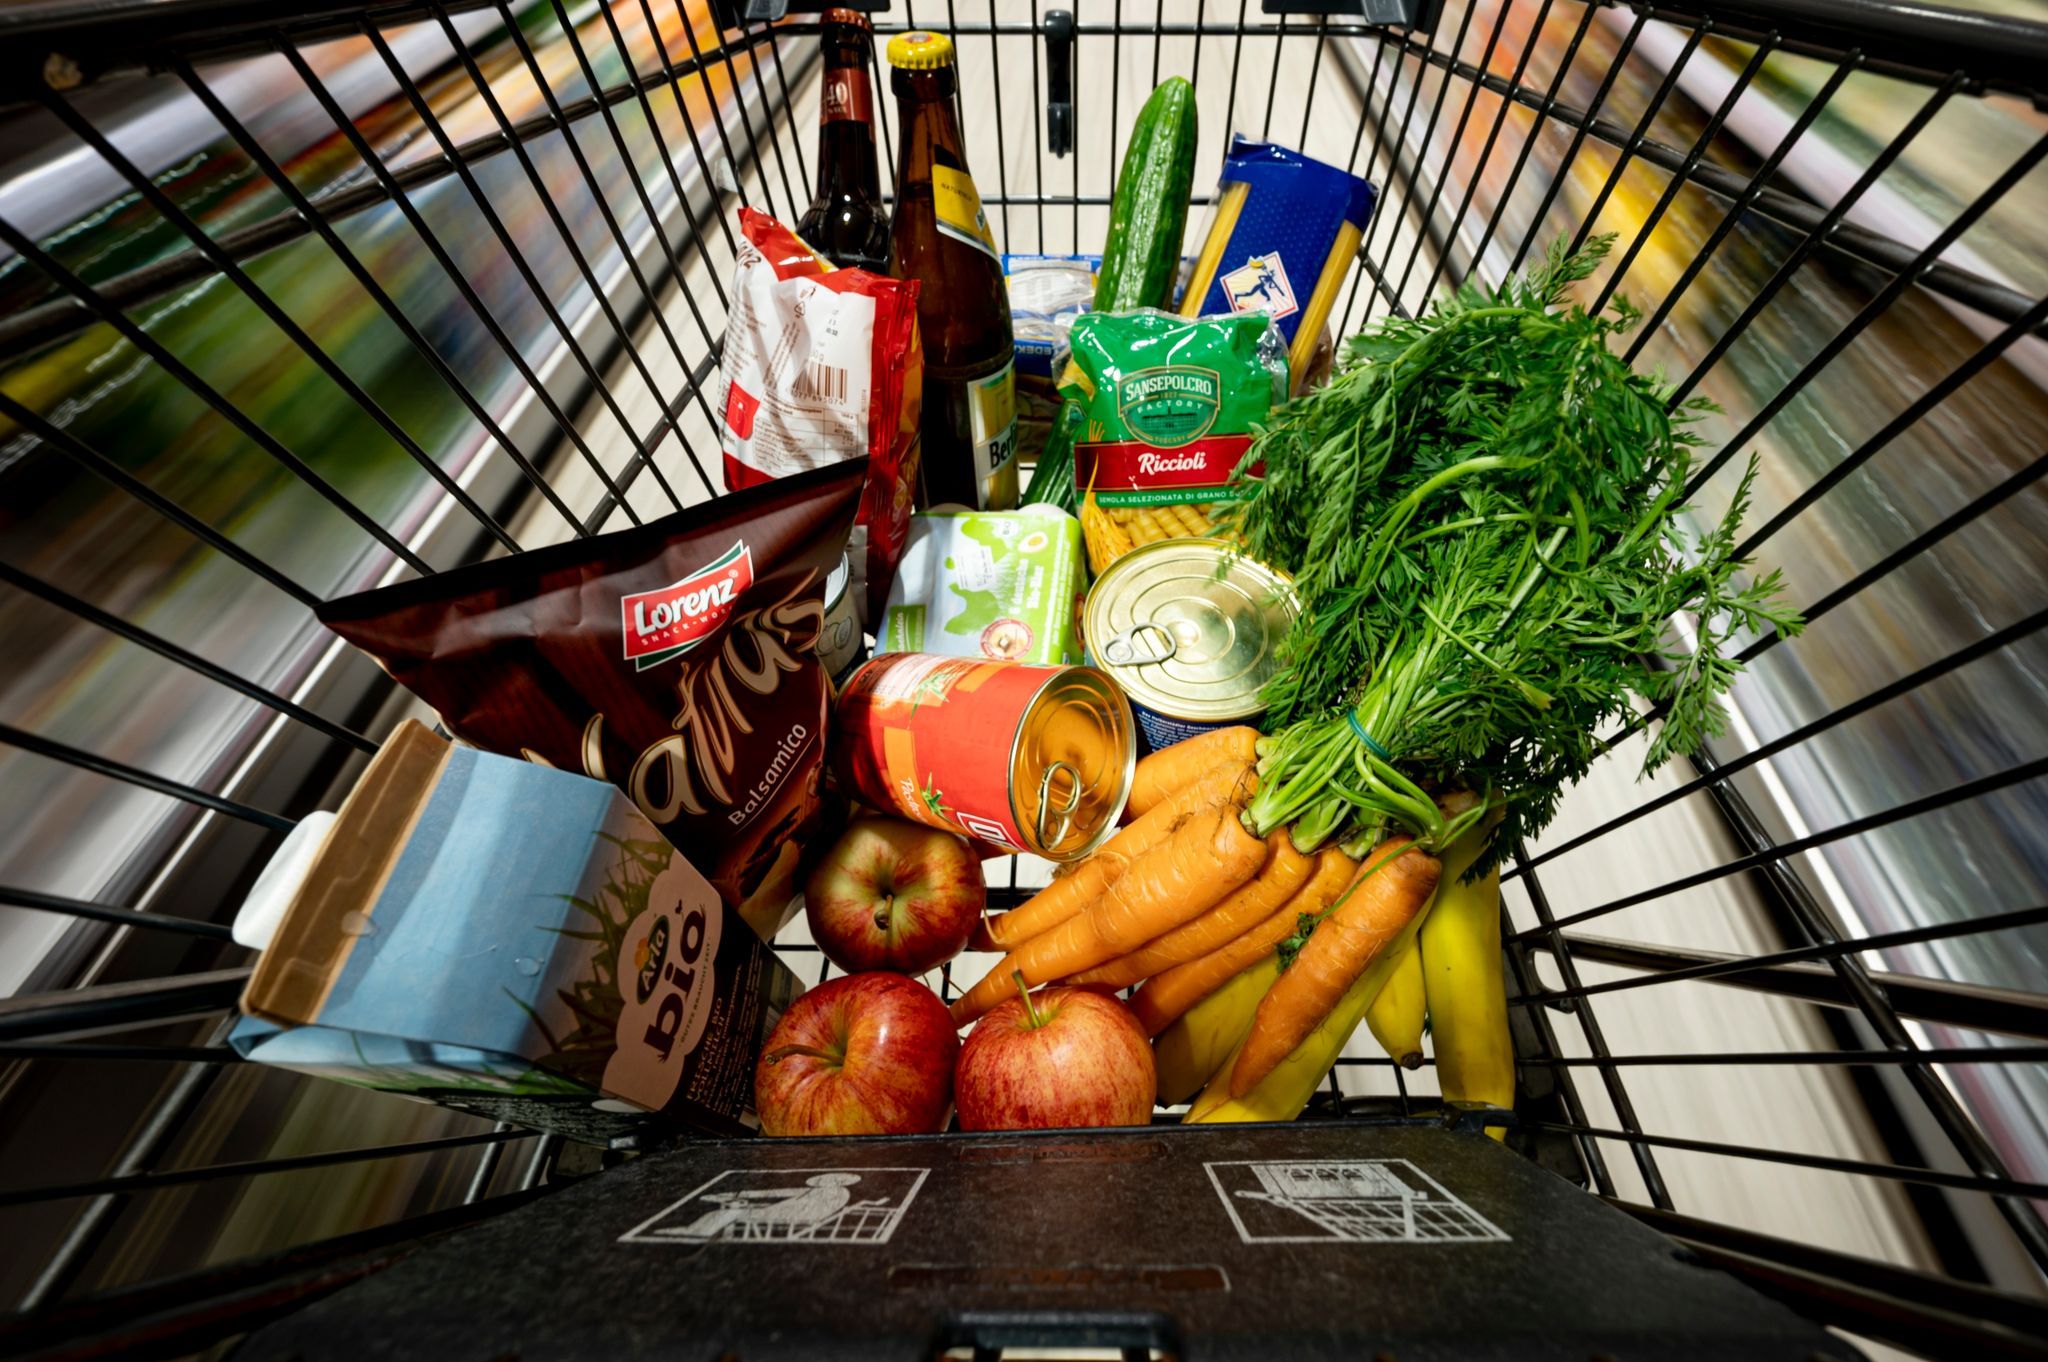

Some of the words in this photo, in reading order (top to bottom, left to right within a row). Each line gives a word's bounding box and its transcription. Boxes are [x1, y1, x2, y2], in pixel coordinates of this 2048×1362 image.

[1125, 376, 1212, 400] SANSEPOLCRO
[1137, 400, 1204, 413] FACTORY
[1138, 452, 1206, 475] Riccioli
[1128, 494, 1182, 503] SELEZIONATA
[1197, 491, 1226, 499] GRANO
[634, 578, 738, 638] Lorenz
[728, 723, 807, 827] Balsamico
[641, 929, 667, 992] Arla
[643, 908, 706, 1062] bio
[711, 997, 722, 1025] BIO
